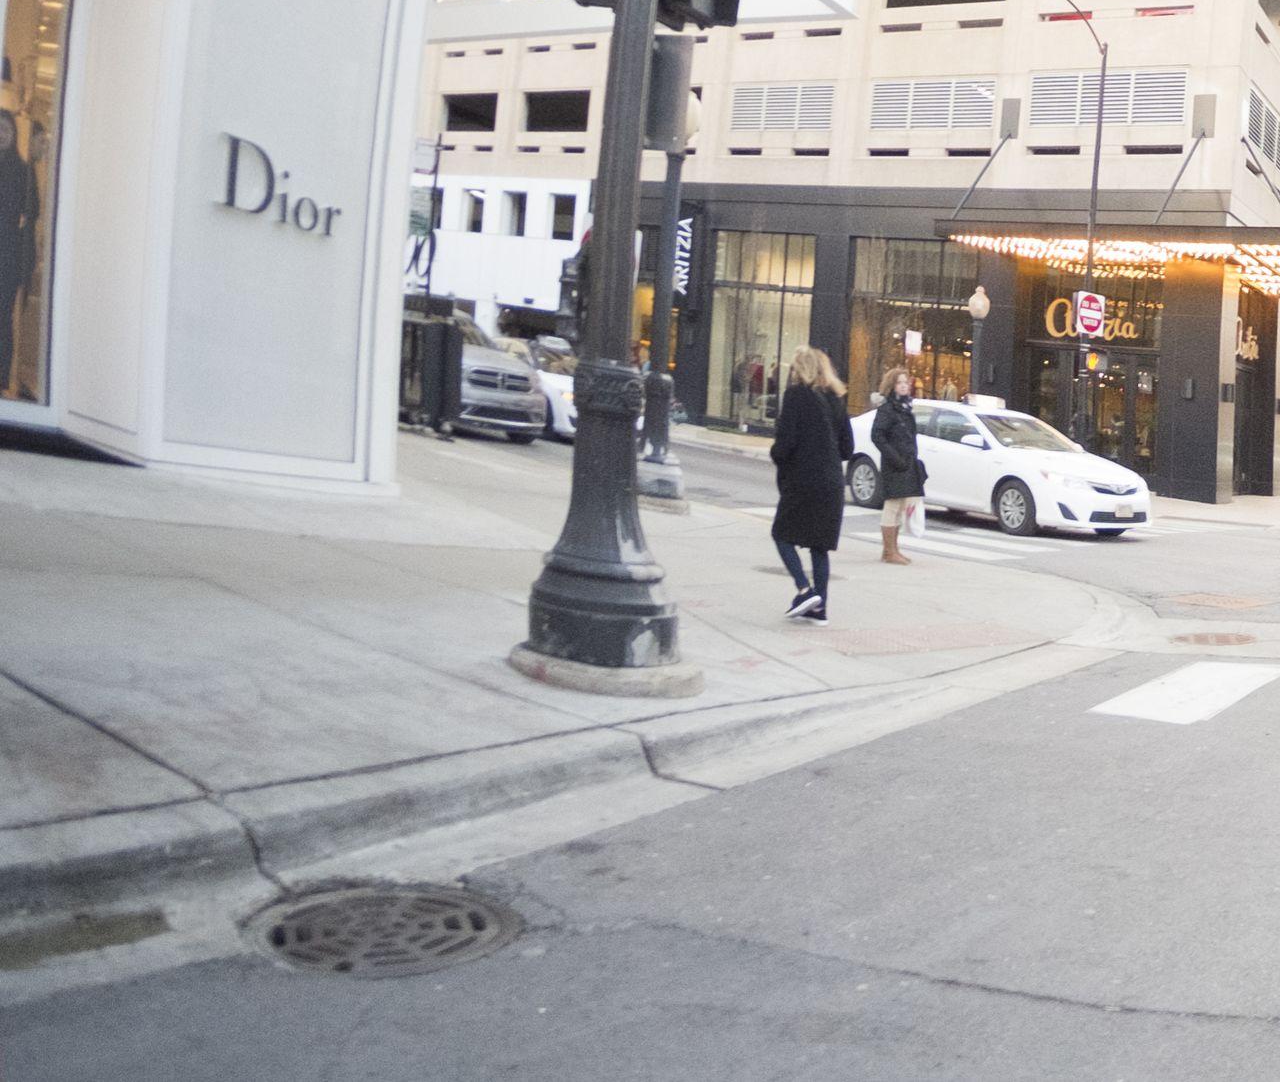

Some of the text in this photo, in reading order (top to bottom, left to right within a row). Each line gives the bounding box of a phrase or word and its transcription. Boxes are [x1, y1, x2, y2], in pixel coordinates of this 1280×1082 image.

[214, 132, 342, 237] Dior
[672, 217, 694, 296] ARITZIA
[1081, 300, 1102, 310] DO NOT
